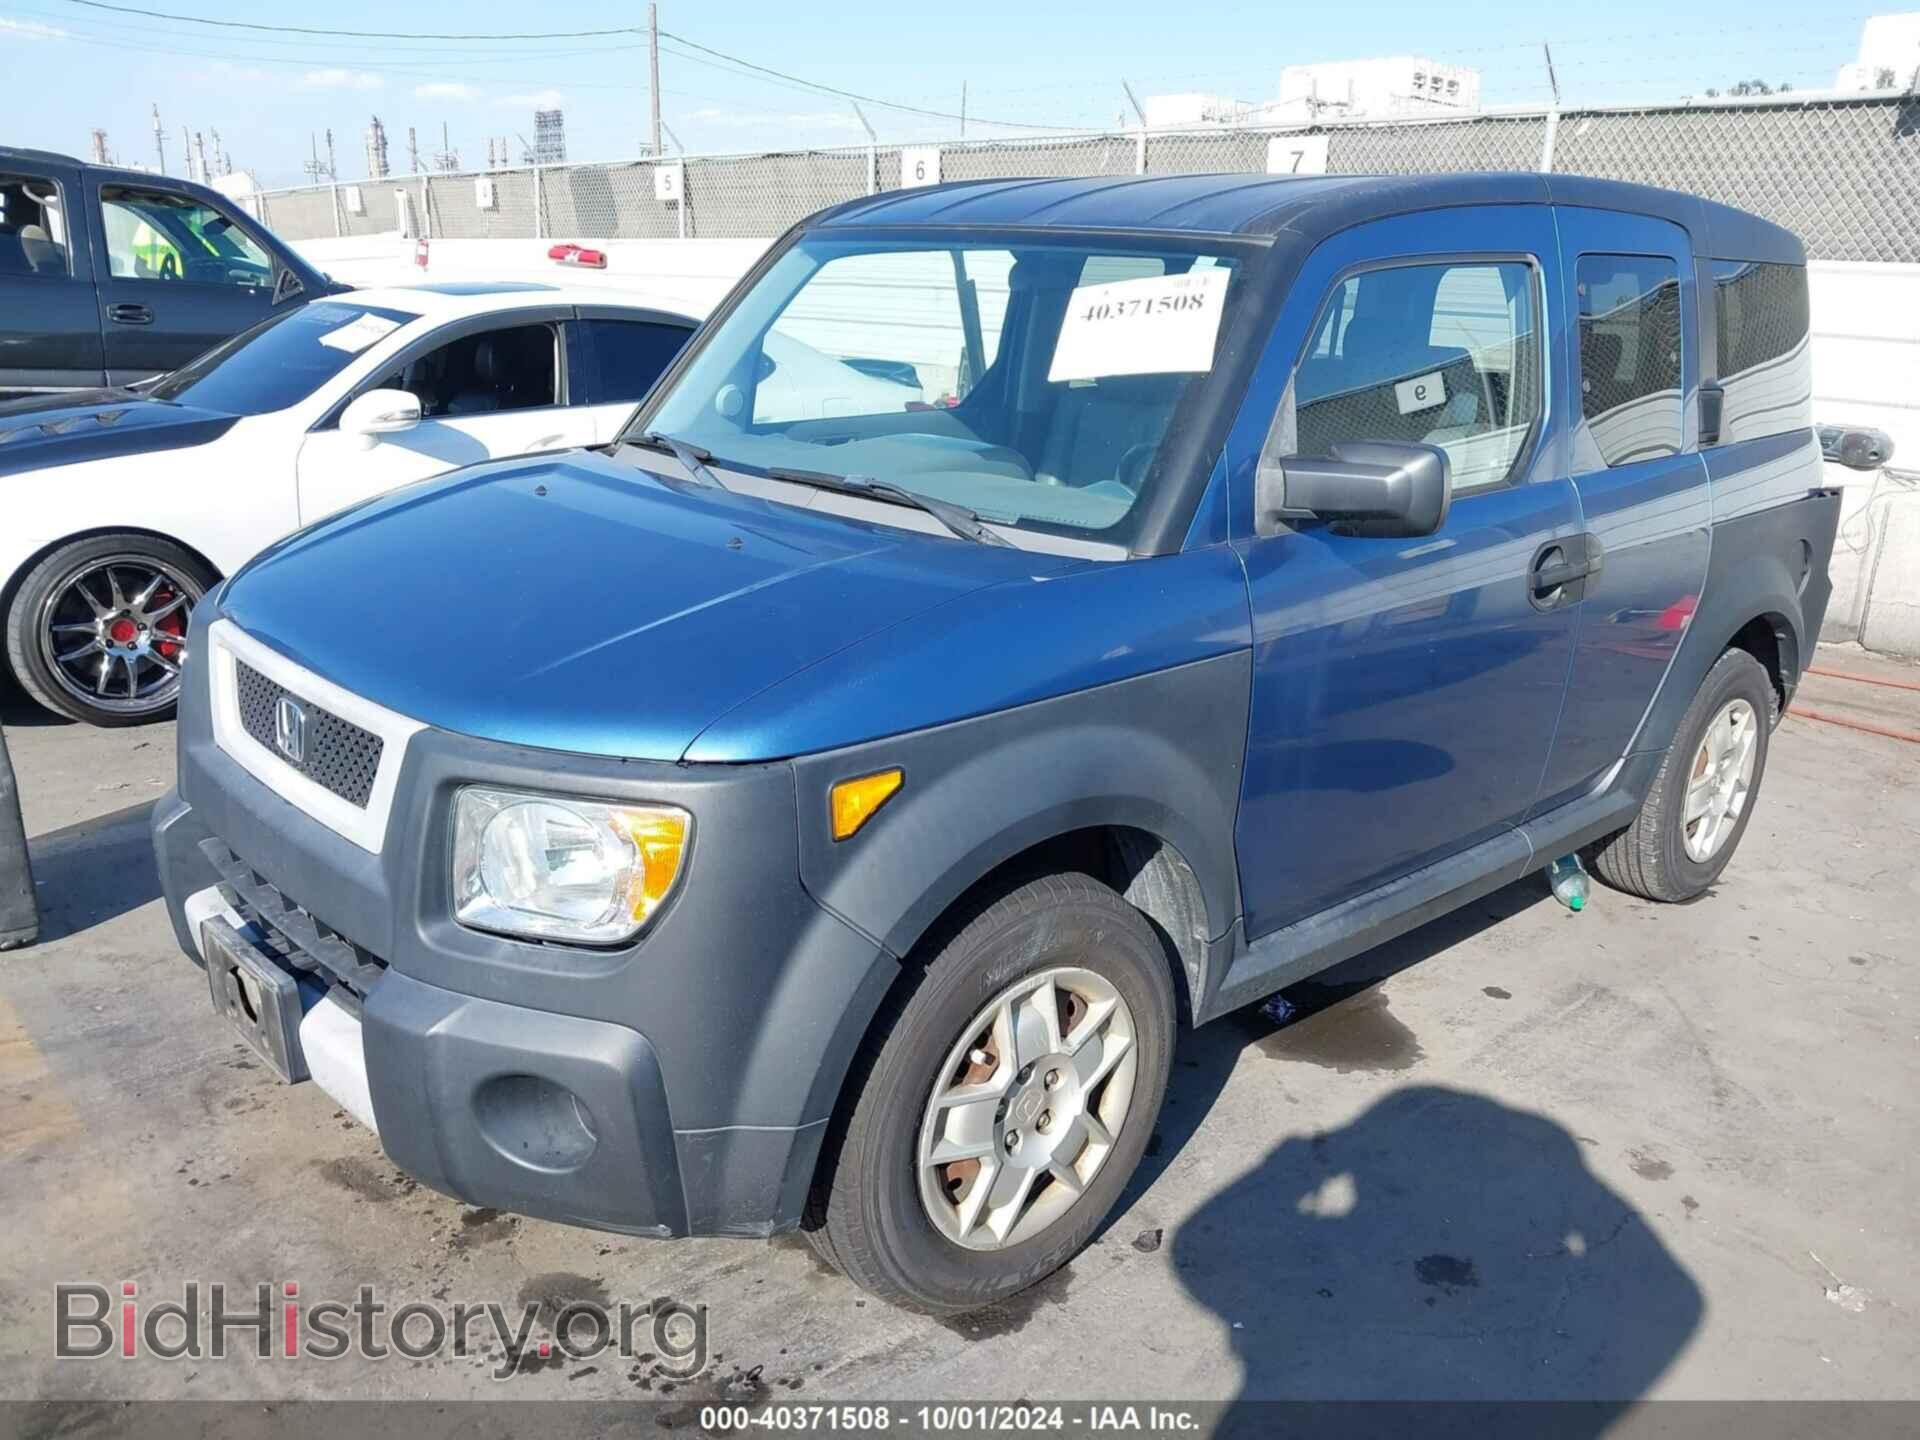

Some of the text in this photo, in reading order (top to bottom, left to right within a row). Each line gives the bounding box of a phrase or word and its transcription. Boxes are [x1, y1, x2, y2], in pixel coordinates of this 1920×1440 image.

[915, 160, 925, 181] 6
[1290, 150, 1305, 175] 7
[664, 174, 672, 191] 5
[1080, 293, 1205, 322] 40371508
